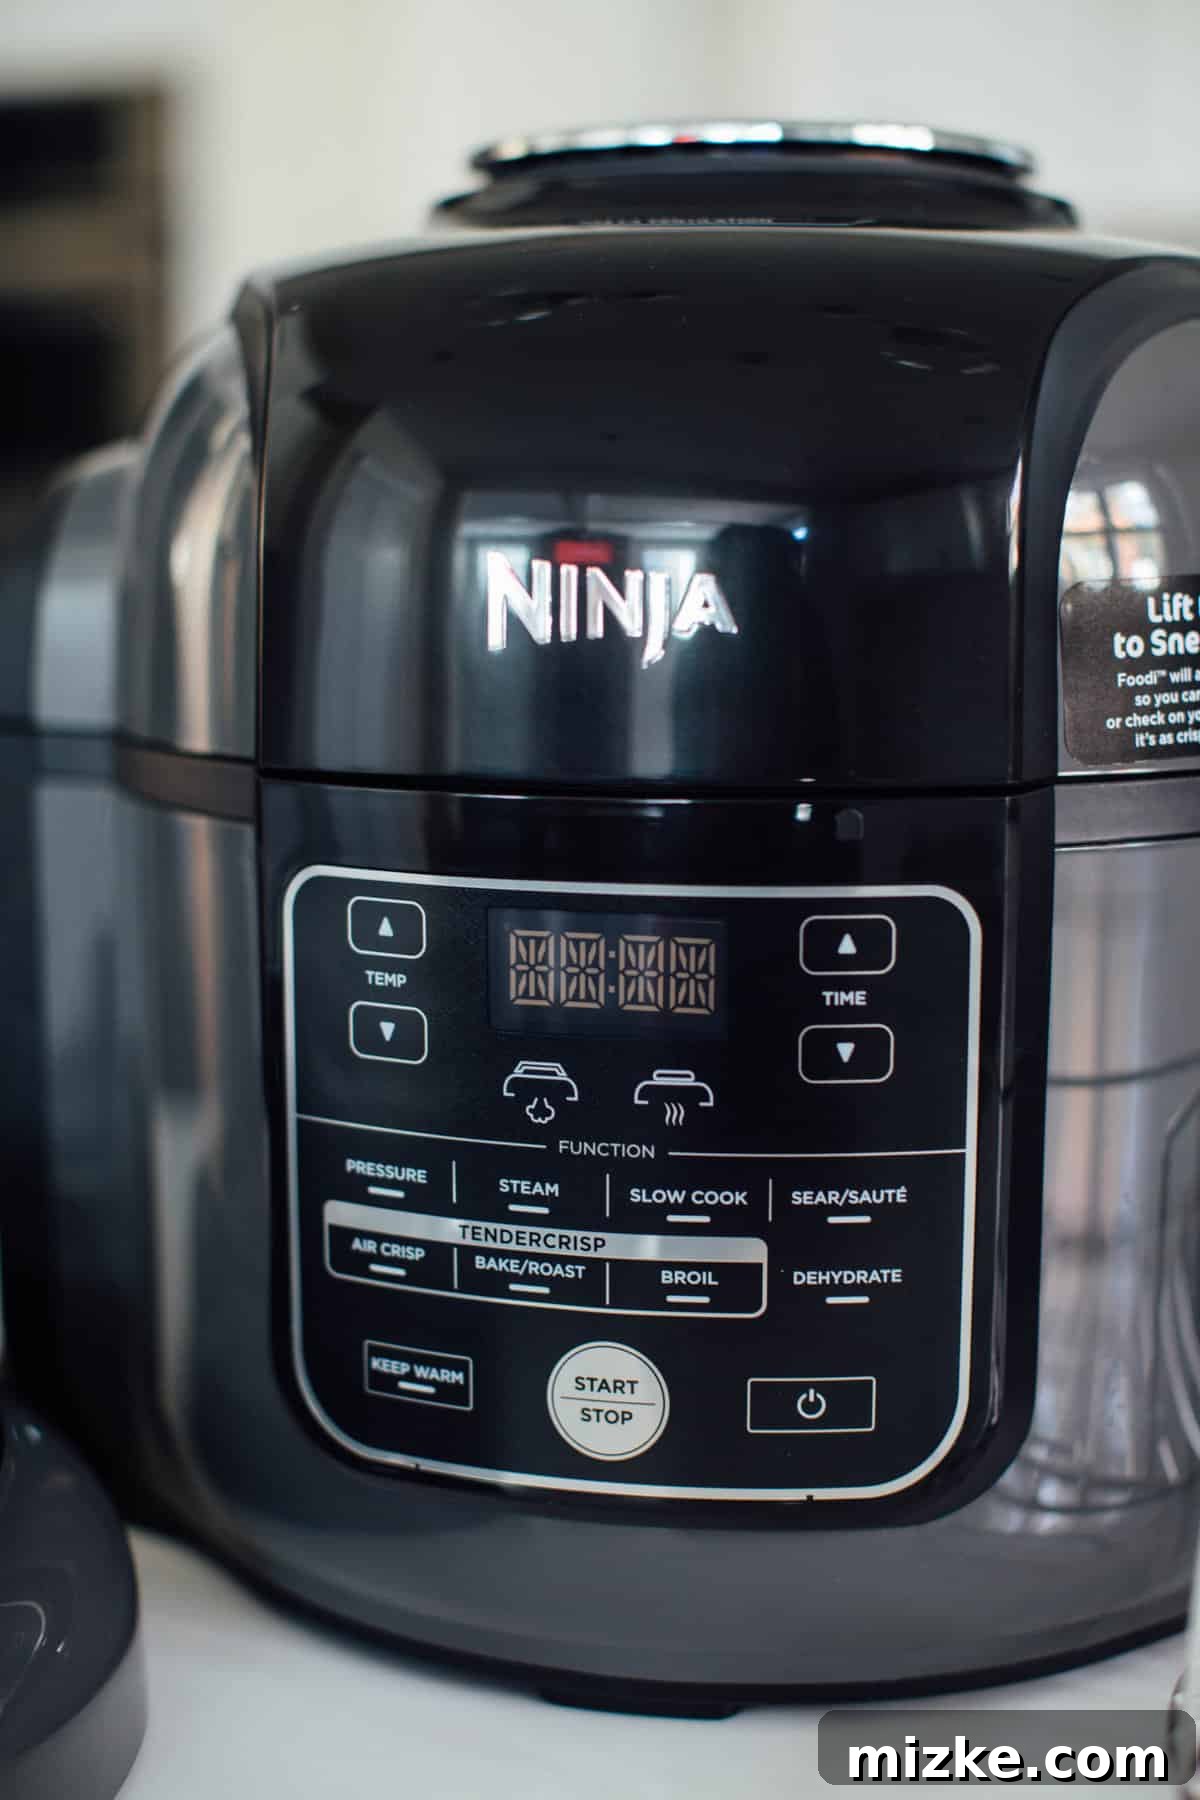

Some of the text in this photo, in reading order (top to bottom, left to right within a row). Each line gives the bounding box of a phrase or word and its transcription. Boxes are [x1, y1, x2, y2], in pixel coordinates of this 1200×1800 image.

[488, 551, 738, 669] NINJA
[1147, 591, 1195, 623] Lift
[1113, 631, 1145, 659] to
[1169, 667, 1193, 684] will
[1135, 693, 1151, 707] so
[1154, 691, 1179, 708] you
[1106, 716, 1122, 729] or
[1125, 709, 1166, 728] check
[1168, 711, 1185, 725] on
[1135, 731, 1156, 748] it's
[1159, 732, 1174, 746] as
[365, 970, 407, 988] TEMP
[822, 990, 867, 1006] TIME
[559, 1140, 655, 1159] FUNCTION
[345, 1158, 428, 1183] PRESSURE
[499, 1179, 559, 1197] STEAM
[629, 1187, 748, 1206] SLOW COOK
[791, 1185, 908, 1206] SEAR/SAUTÉ
[459, 1224, 606, 1252] TENDERCRISP
[351, 1237, 425, 1261] AIR CRISP
[475, 1255, 586, 1279] BAKE/ROAST
[661, 1270, 719, 1286] BROIL
[792, 1268, 903, 1286] DEHYDRATE
[371, 1356, 464, 1385] KEEP WARM
[574, 1376, 639, 1395] START
[580, 1407, 633, 1425] STOP
